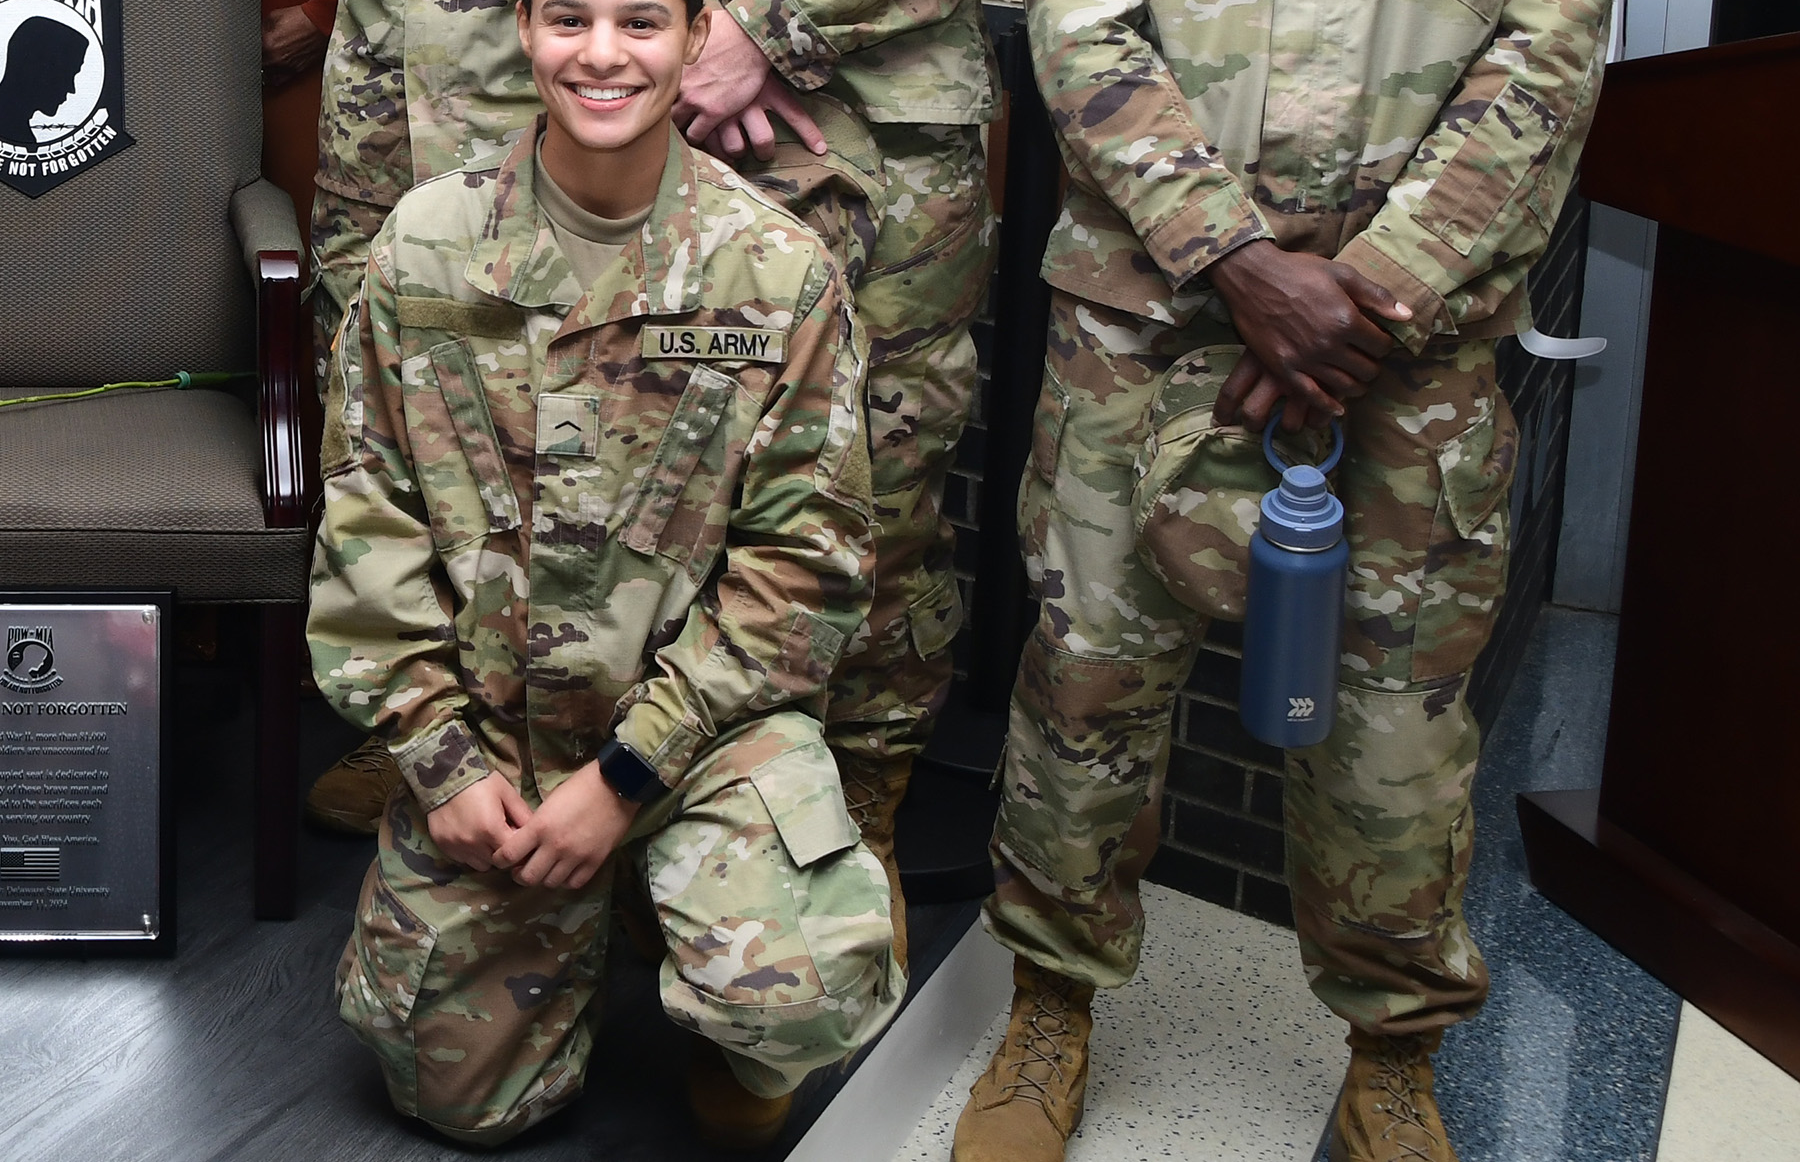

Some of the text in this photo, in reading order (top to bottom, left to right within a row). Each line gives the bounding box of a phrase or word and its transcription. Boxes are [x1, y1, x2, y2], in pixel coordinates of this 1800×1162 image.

[8, 160, 37, 178] NOT
[42, 125, 118, 177] FORGOTTEN
[660, 332, 770, 356] U.S. ARMY
[6, 625, 54, 651] POW MIA
[2, 701, 34, 716] NOT
[37, 701, 128, 716] FORGOTTEN
[6, 731, 24, 742] War
[24, 731, 34, 742] II,
[36, 731, 58, 742] more
[58, 731, 78, 742] than
[79, 731, 108, 742] 81,000
[27, 745, 41, 756] are
[42, 745, 95, 756] unaccounted
[96, 745, 110, 756] for.
[26, 769, 44, 782] seat
[46, 769, 54, 782] is
[56, 769, 98, 782] dedicated
[100, 769, 109, 782] to
[6, 784, 17, 796] of
[18, 784, 42, 796] these
[43, 784, 68, 796] brave
[70, 784, 90, 796] men
[91, 784, 108, 796] and
[11, 798, 21, 810] to
[22, 798, 37, 810] the
[38, 798, 80, 810] sacrifices
[81, 798, 102, 810] each
[5, 812, 38, 826] serving
[40, 812, 55, 826] our
[56, 812, 92, 826] country.
